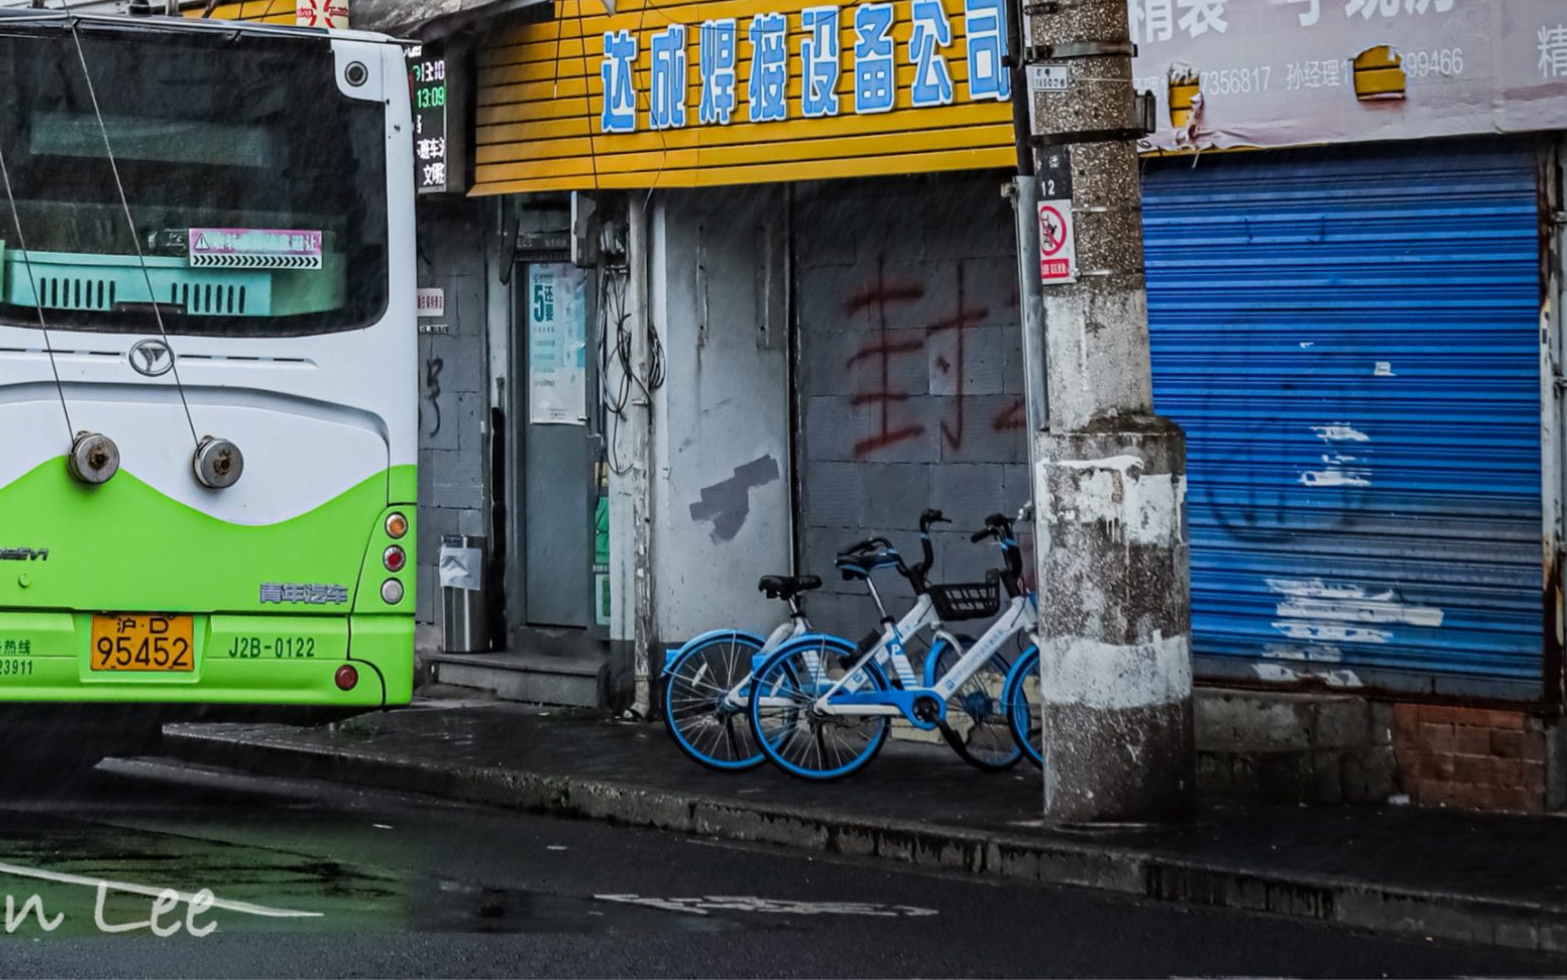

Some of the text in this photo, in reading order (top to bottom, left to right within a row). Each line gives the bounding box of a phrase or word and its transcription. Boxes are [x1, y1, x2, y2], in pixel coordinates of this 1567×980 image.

[421, 60, 445, 82] 13:10
[417, 86, 446, 108] 13:09
[1042, 179, 1055, 196] 12
[260, 584, 348, 605] 青年汽车
[97, 636, 189, 667] 95452
[229, 637, 315, 659] J2B-0122
[891, 644, 901, 655] P
